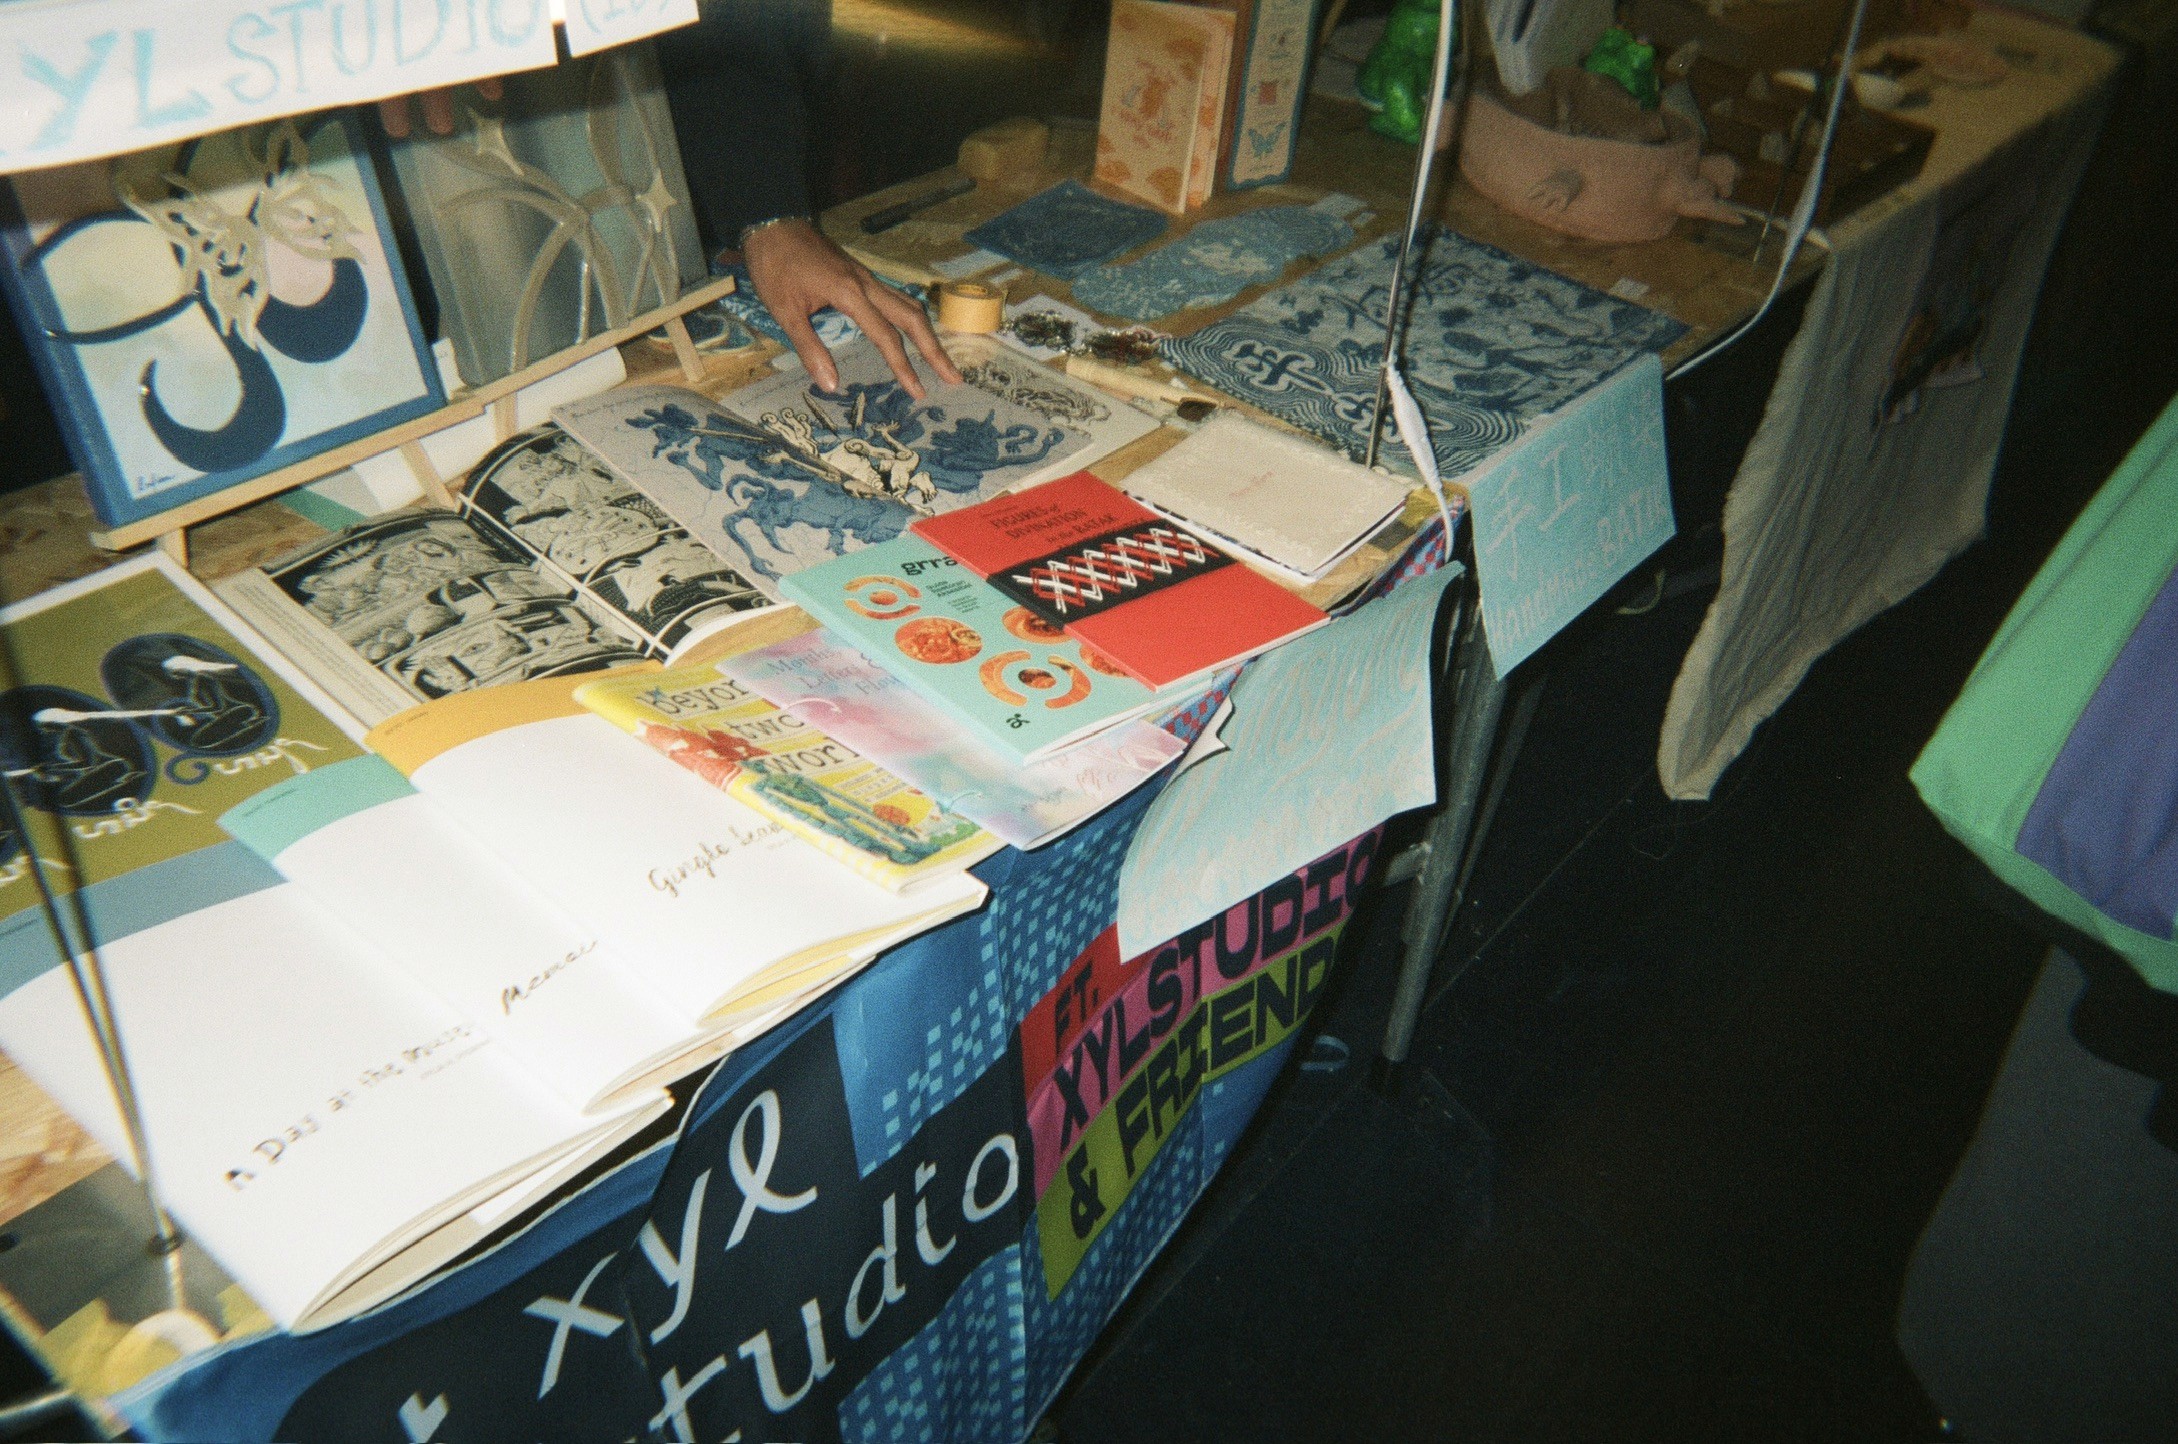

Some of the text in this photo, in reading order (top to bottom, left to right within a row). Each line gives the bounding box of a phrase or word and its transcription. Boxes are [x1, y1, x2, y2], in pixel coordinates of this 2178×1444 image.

[0, 30, 213, 156] YL
[991, 506, 1047, 529] FIGURES
[1005, 508, 1088, 539] DIVINATION
[1053, 961, 1099, 1059] FT.
[1066, 1137, 1107, 1241] &
[522, 1089, 817, 1400] xyl
[623, 1132, 1020, 1444] tudio
